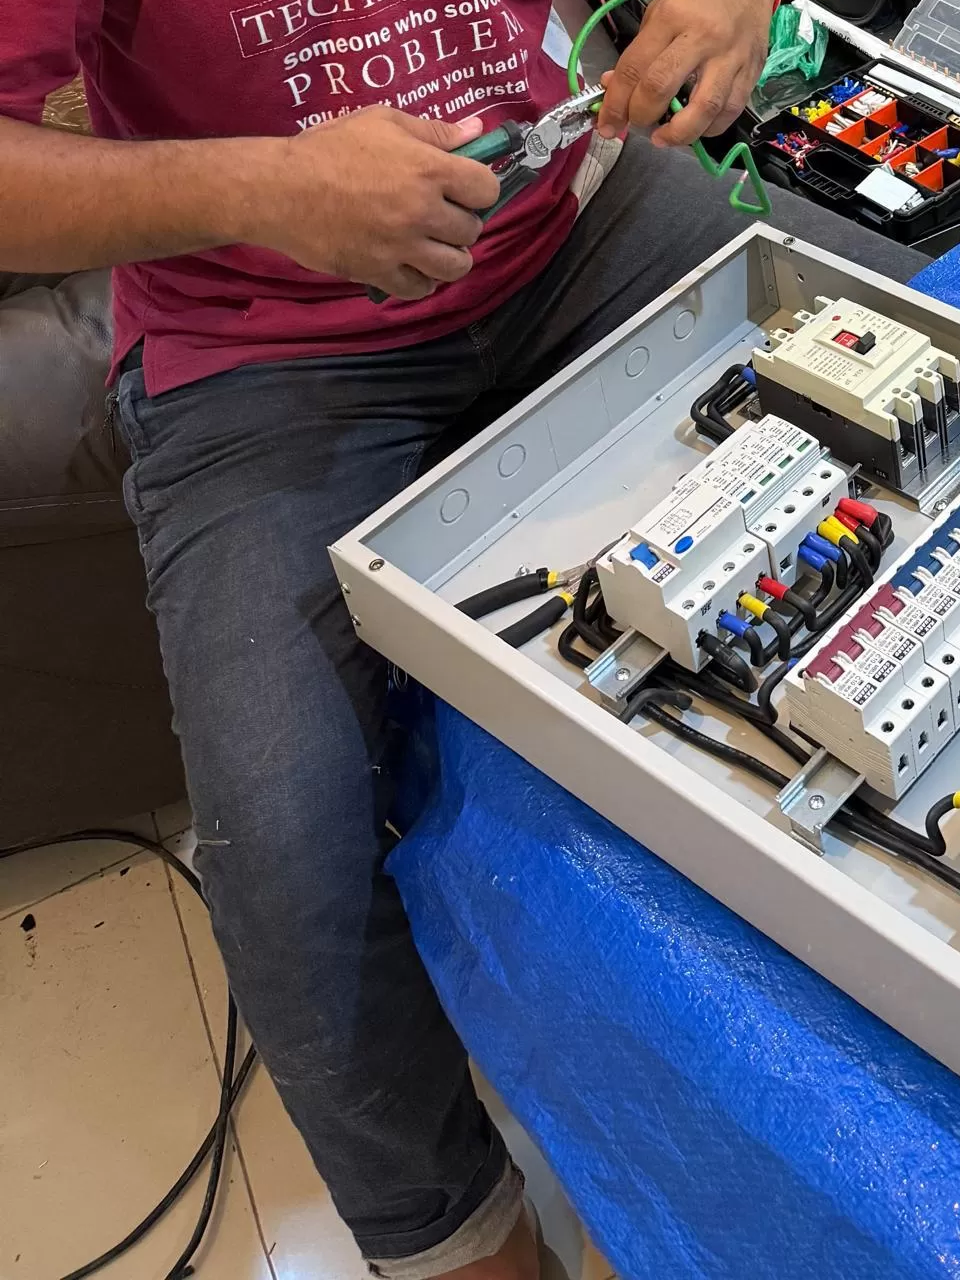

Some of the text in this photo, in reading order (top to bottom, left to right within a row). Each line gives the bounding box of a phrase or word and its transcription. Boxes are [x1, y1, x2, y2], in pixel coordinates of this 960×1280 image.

[283, 26, 391, 71] someone
[395, 8, 437, 35] who
[296, 109, 336, 131] you
[397, 78, 440, 109] know
[443, 67, 475, 94] you
[482, 56, 517, 77] had
[915, 617, 932, 633] GUARD
[923, 620, 935, 631] MAX
[893, 639, 911, 657] GUARD
[901, 642, 914, 655] MAX
[873, 661, 891, 679] GUARD
[881, 664, 894, 676] MAX
[852, 683, 871, 702] GUARD
[861, 686, 875, 699] MAX
